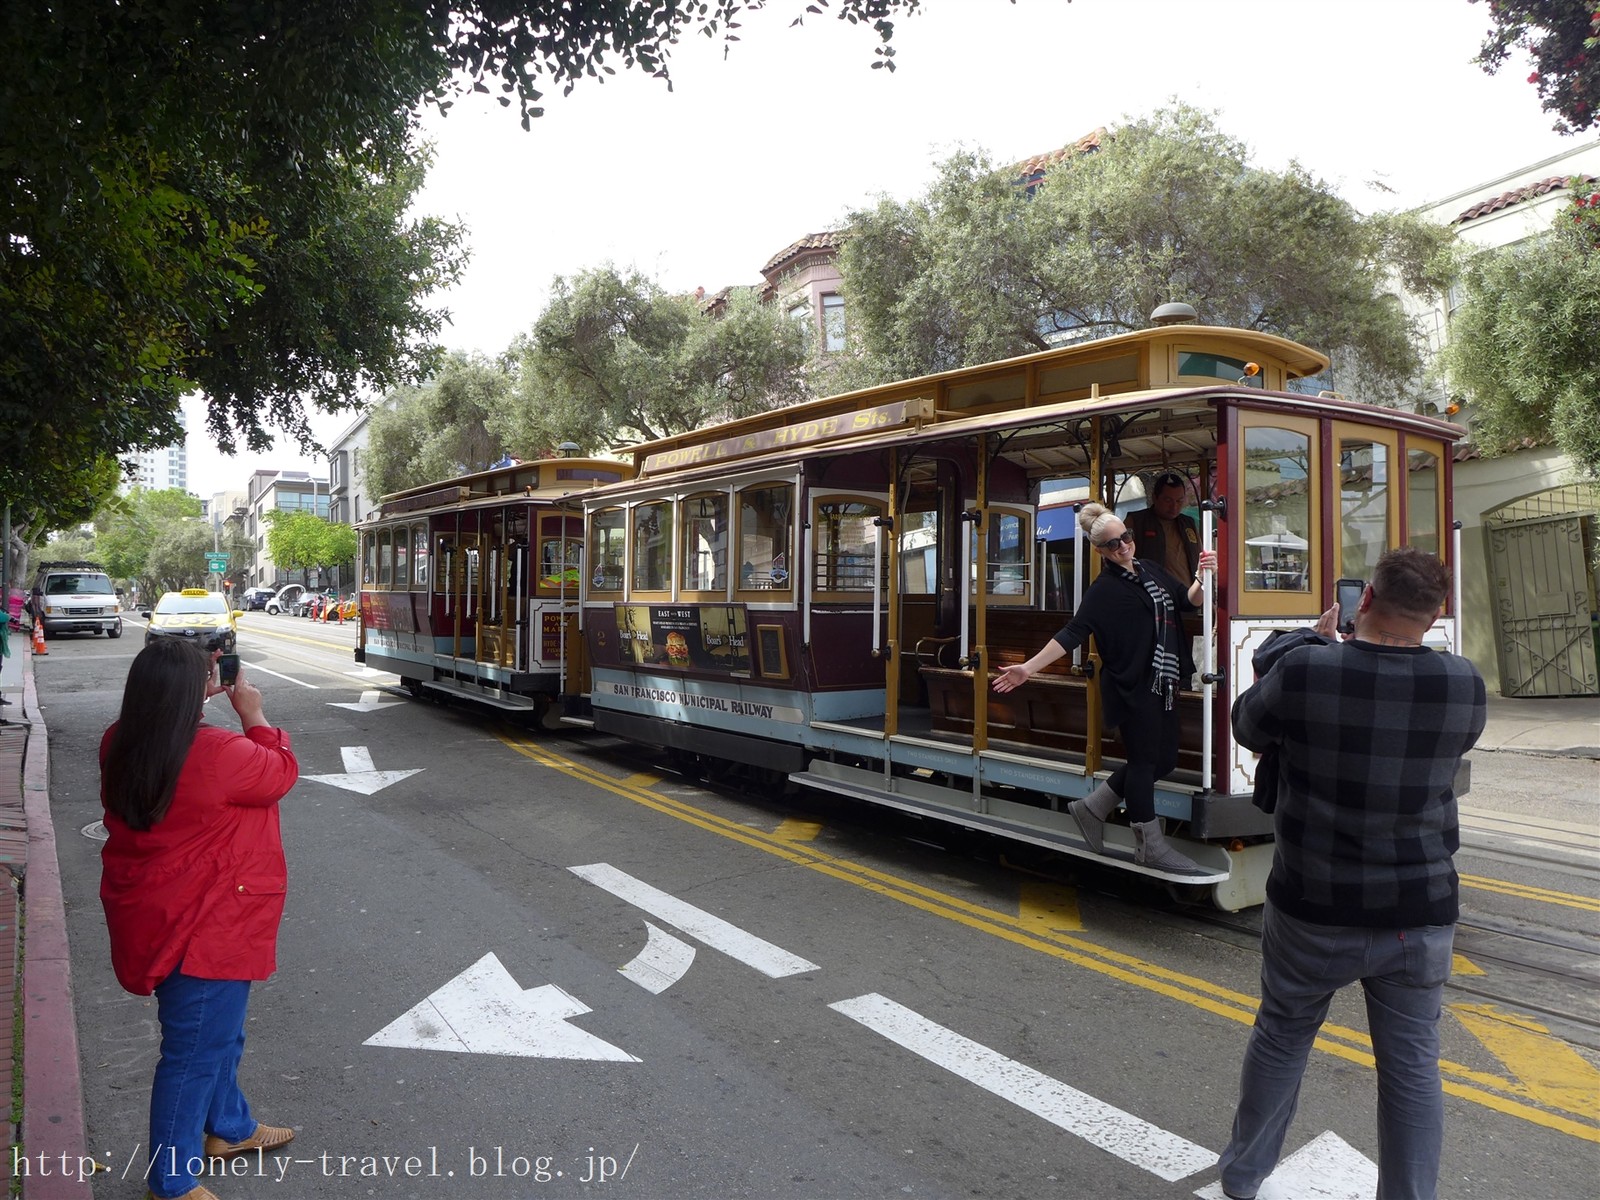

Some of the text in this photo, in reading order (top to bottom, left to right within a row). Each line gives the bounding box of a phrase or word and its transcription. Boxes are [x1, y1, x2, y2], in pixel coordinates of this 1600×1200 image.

[655, 442, 727, 468] POWELL
[774, 418, 838, 444] HYDE
[658, 610, 670, 618] EAST
[677, 610, 691, 618] WEST
[161, 615, 217, 626] 1332
[636, 630, 649, 641] Head
[728, 635, 745, 647] Head
[613, 684, 774, 719] SAN FRANCISCO MUNICIPAL RAILWAY
[1046, 776, 1061, 785] ONLY
[1161, 799, 1181, 808] ONLY
